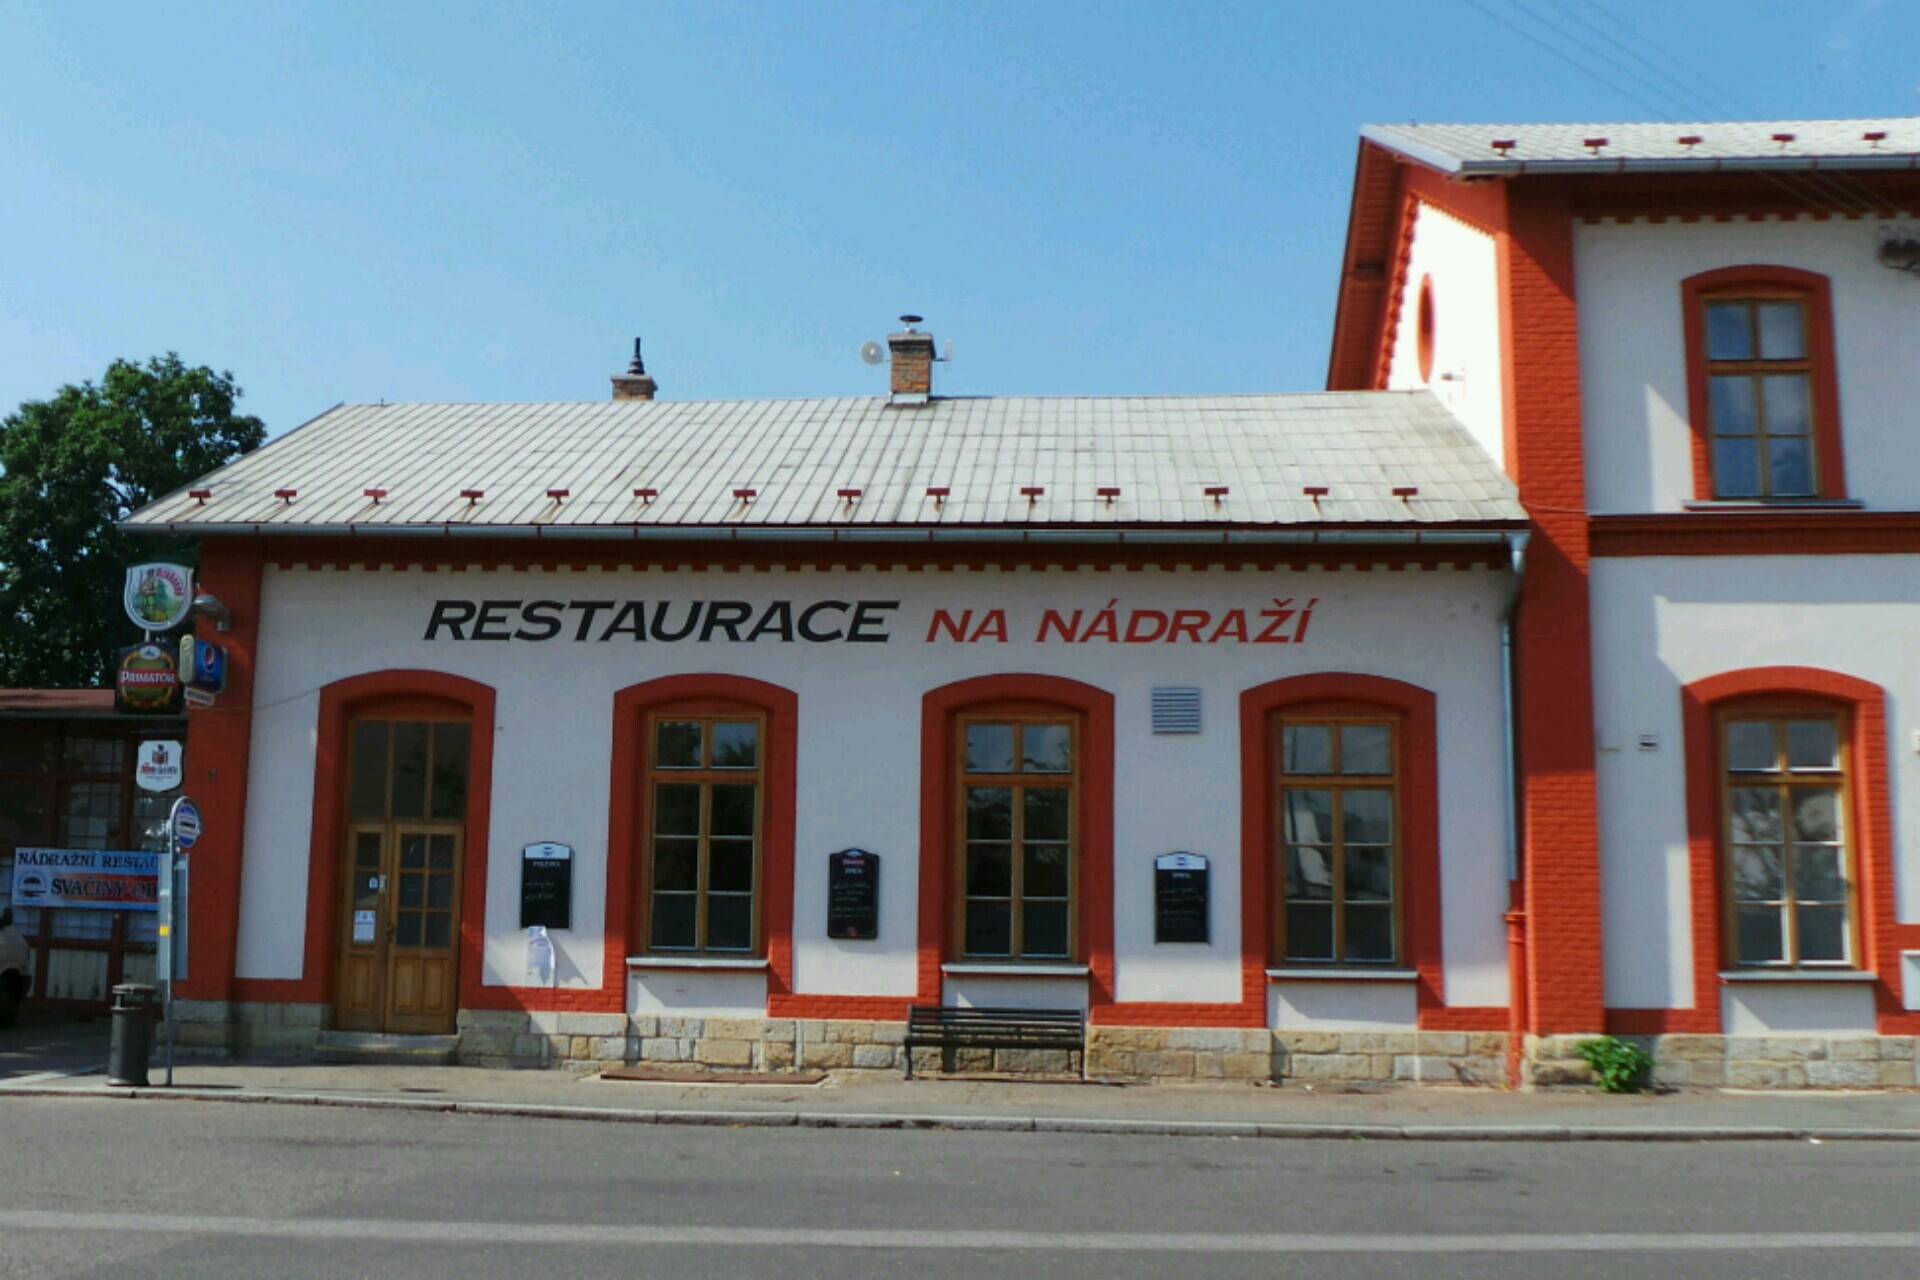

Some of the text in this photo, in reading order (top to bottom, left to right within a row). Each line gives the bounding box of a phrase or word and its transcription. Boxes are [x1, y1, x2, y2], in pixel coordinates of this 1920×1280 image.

[424, 598, 1319, 643] RESTAURACE NA NÁDRAŽÍ
[18, 849, 96, 868] NÁDRAŽNÍ
[51, 875, 126, 896] SVAČINY
